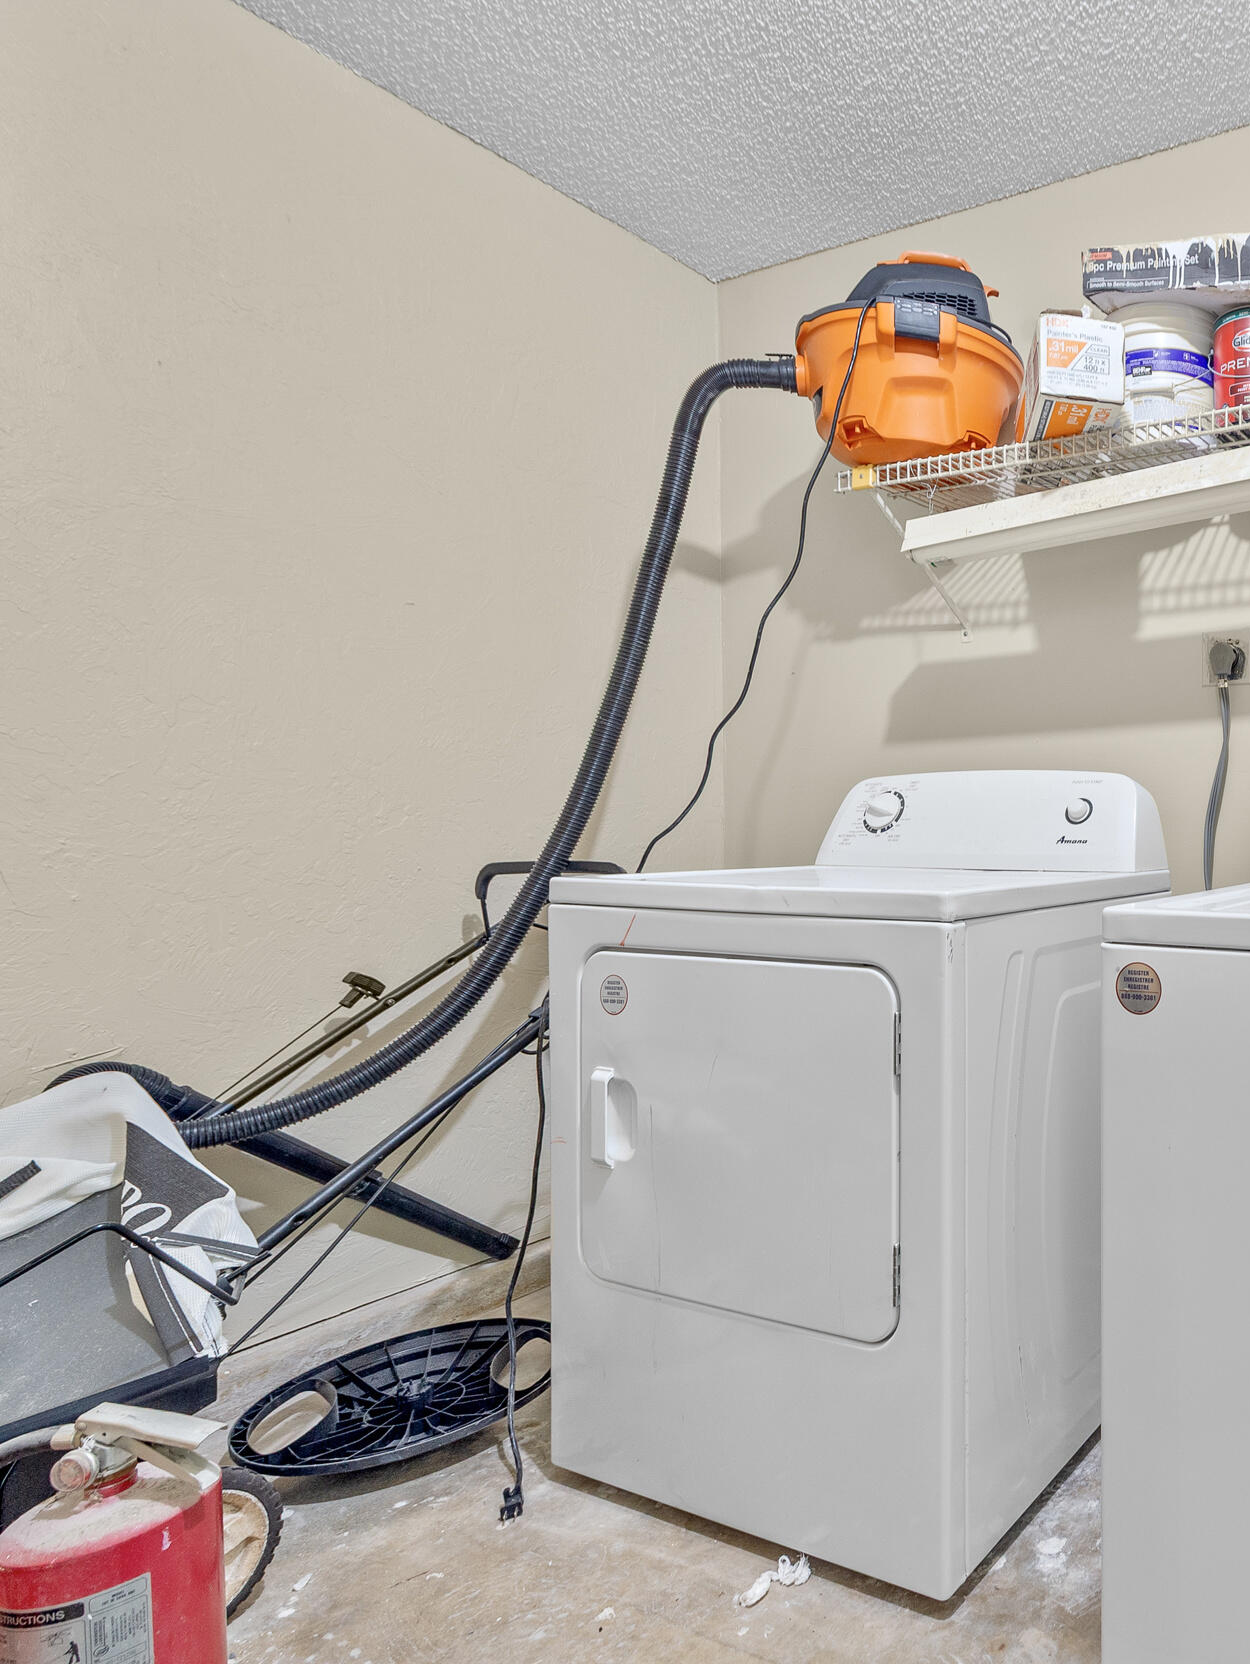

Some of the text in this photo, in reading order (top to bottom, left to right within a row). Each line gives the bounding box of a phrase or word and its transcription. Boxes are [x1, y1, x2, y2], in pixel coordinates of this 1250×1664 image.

[1185, 254, 1199, 265] Set
[1047, 329, 1103, 342] Painter's Plastic
[1048, 340, 1064, 352] .31
[1056, 835, 1088, 845] Amana
